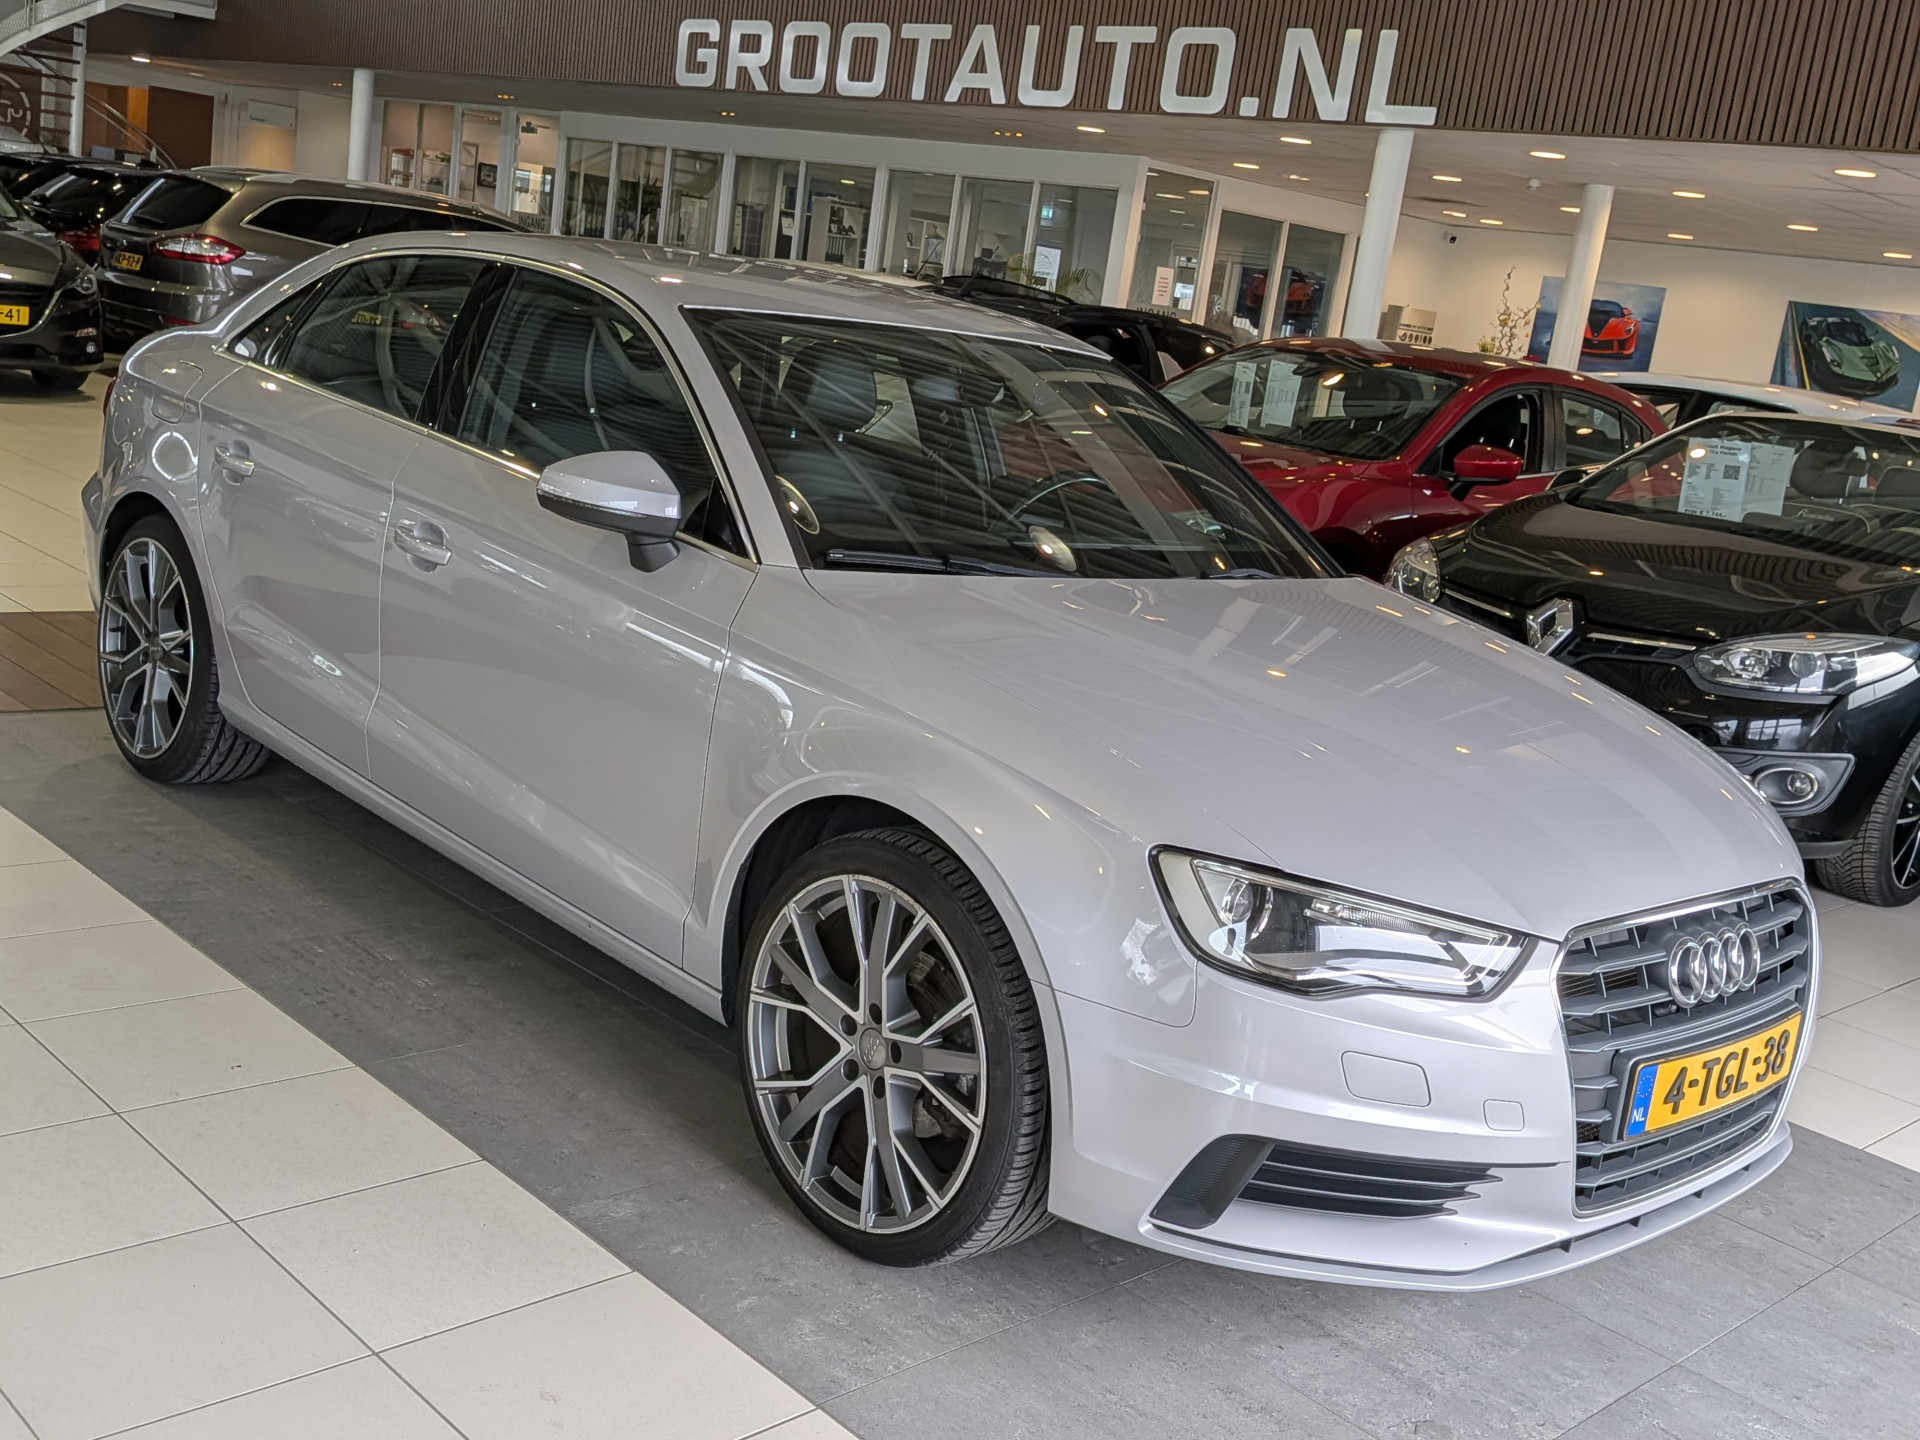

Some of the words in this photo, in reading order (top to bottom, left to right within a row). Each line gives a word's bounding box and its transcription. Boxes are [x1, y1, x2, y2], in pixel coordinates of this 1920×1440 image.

[675, 18, 1438, 126] GROOTAUTO.NL
[518, 215, 546, 231] INGANG
[1663, 1028, 1791, 1115] 4-TGL-38
[1631, 1108, 1645, 1124] NL
